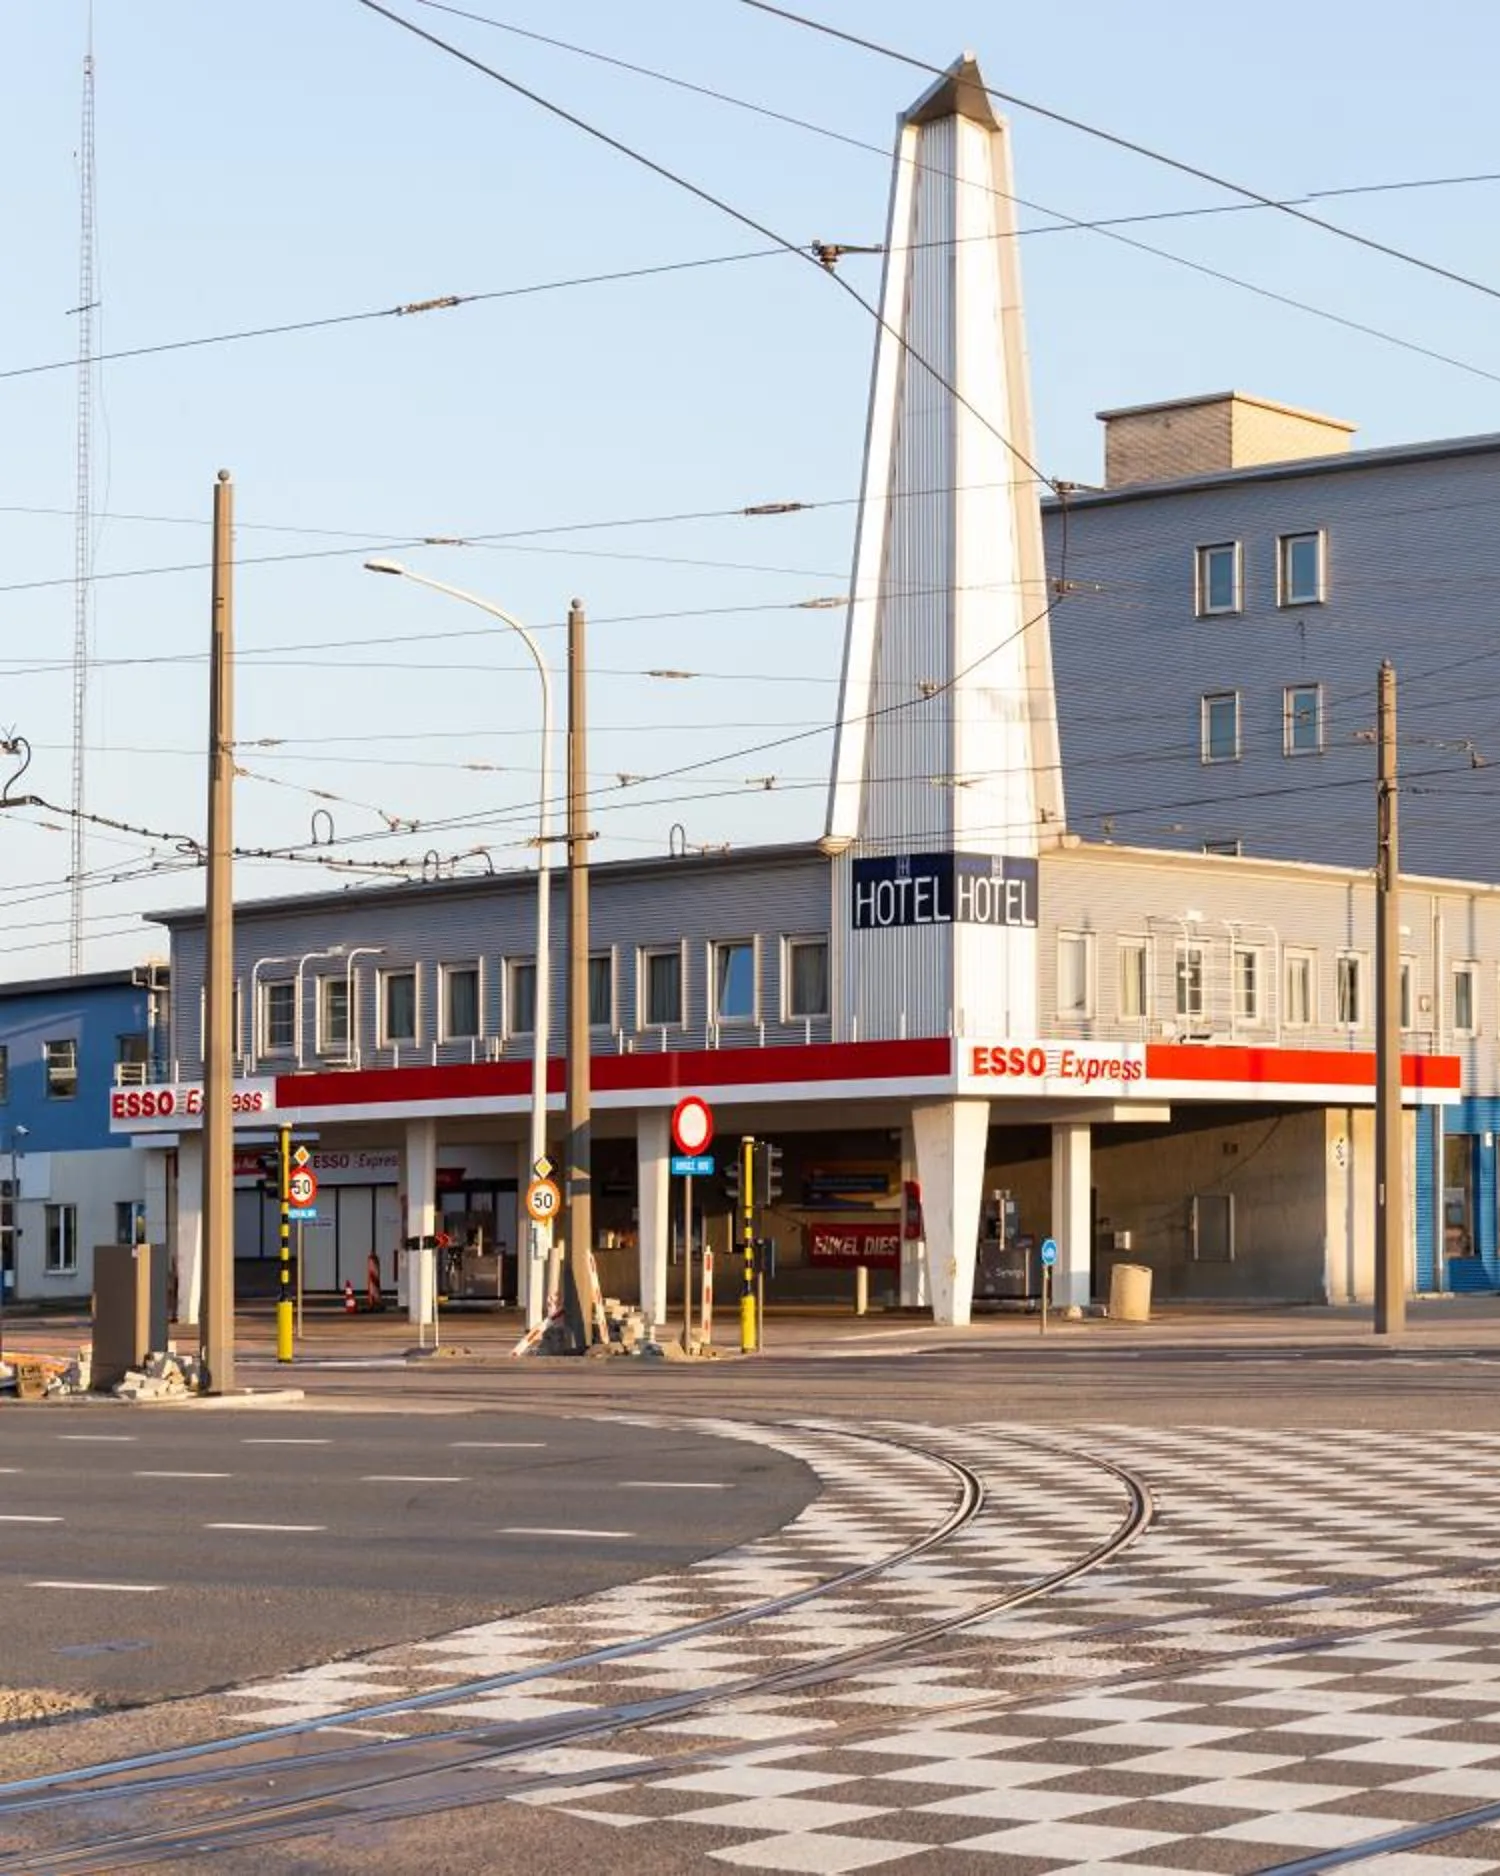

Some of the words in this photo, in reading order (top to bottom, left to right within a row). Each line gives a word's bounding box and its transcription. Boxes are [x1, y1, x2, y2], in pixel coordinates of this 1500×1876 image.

[856, 876, 951, 926] HOTEL
[957, 875, 1036, 926] HOTEL
[972, 1046, 1046, 1076] ESSO
[1059, 1049, 1143, 1084] Express
[111, 1090, 174, 1119] ESSO
[185, 1089, 262, 1115] Eess
[312, 1153, 349, 1169] ESSO
[290, 1179, 311, 1195] 50
[533, 1192, 553, 1209] 50
